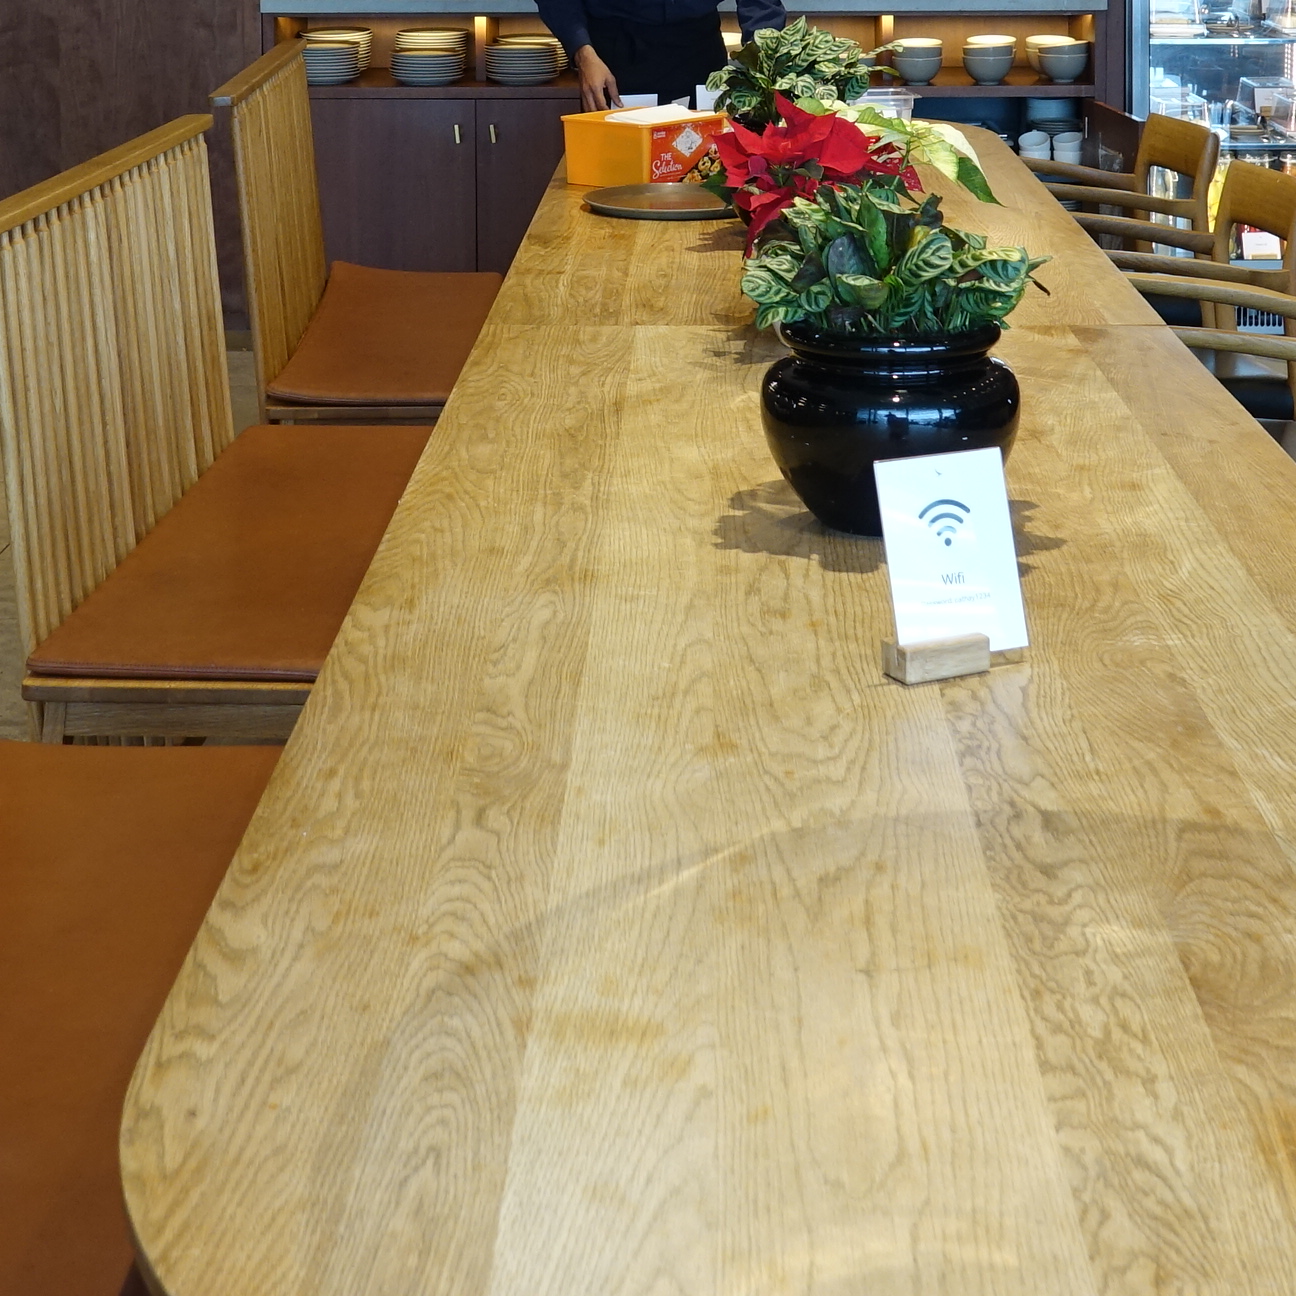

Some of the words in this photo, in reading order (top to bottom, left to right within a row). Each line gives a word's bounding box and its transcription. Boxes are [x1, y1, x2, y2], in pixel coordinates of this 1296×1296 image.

[660, 152, 672, 161] THE
[652, 160, 683, 179] Selection
[941, 571, 965, 585] Wifi
